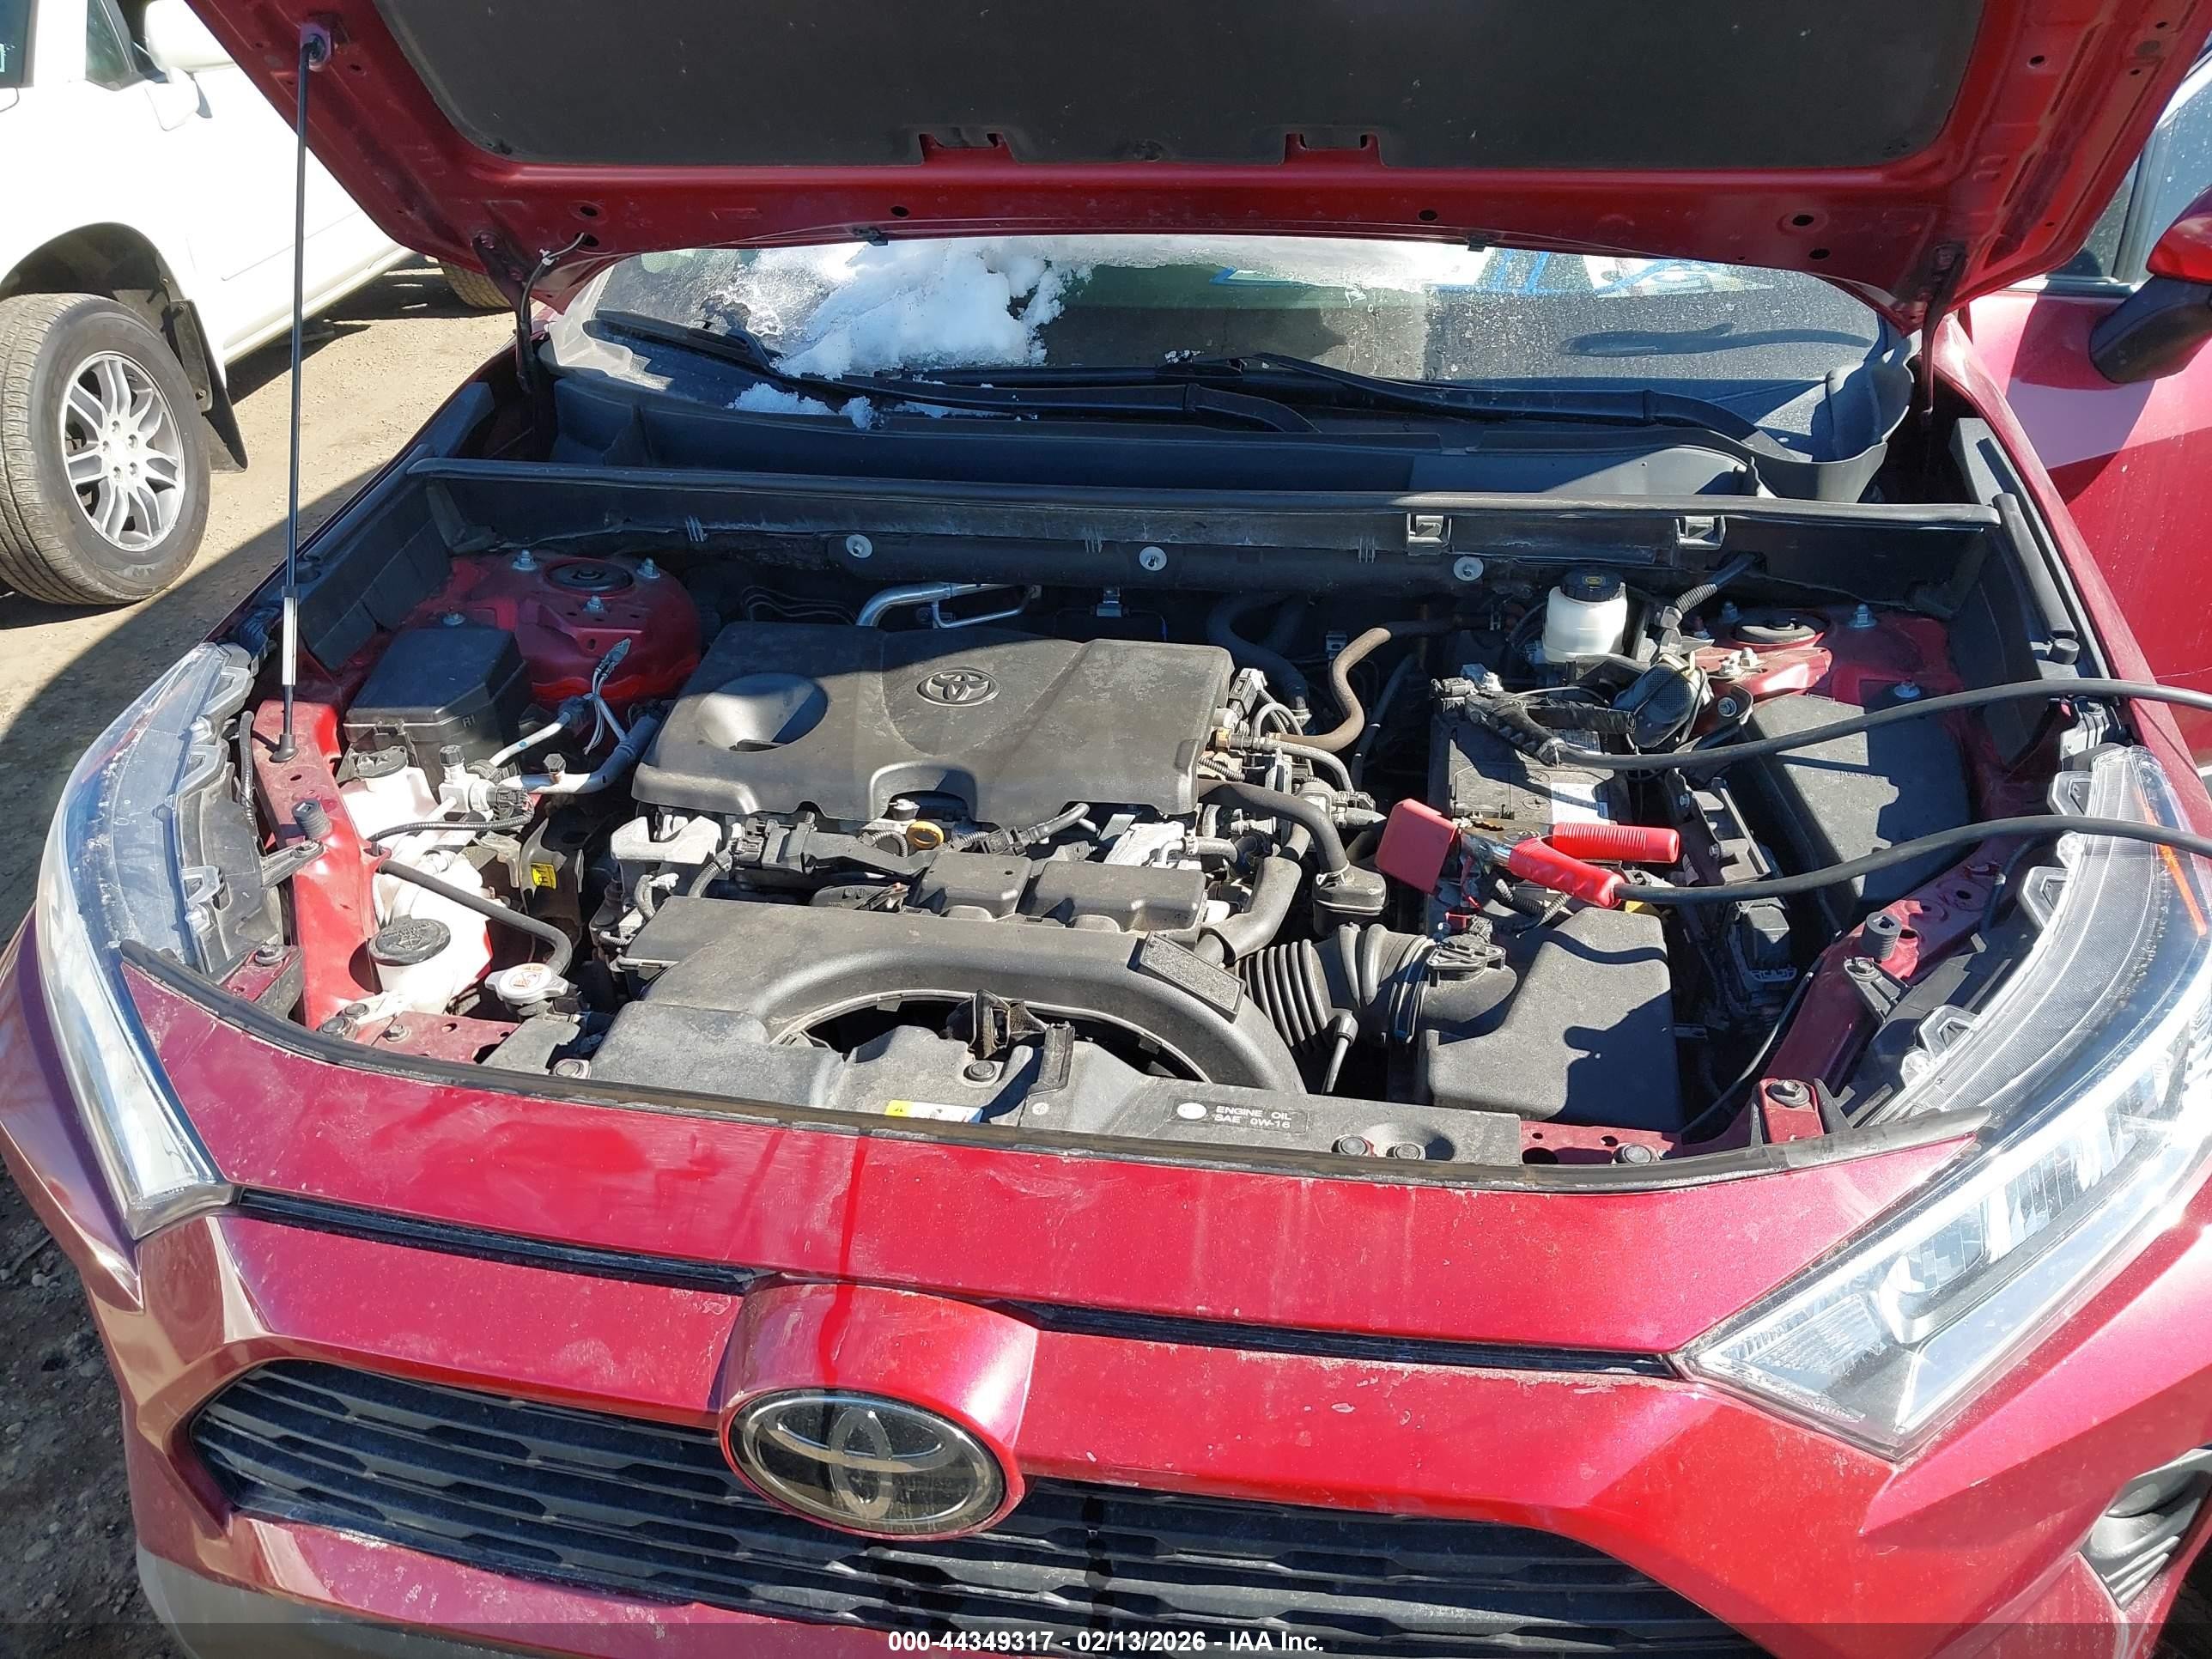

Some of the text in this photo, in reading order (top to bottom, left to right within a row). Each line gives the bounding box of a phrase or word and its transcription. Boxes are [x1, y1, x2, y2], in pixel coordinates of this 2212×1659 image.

[1216, 1105, 1291, 1121] ENGINE OIL
[1214, 1114, 1291, 1128] SAE 0W-16
